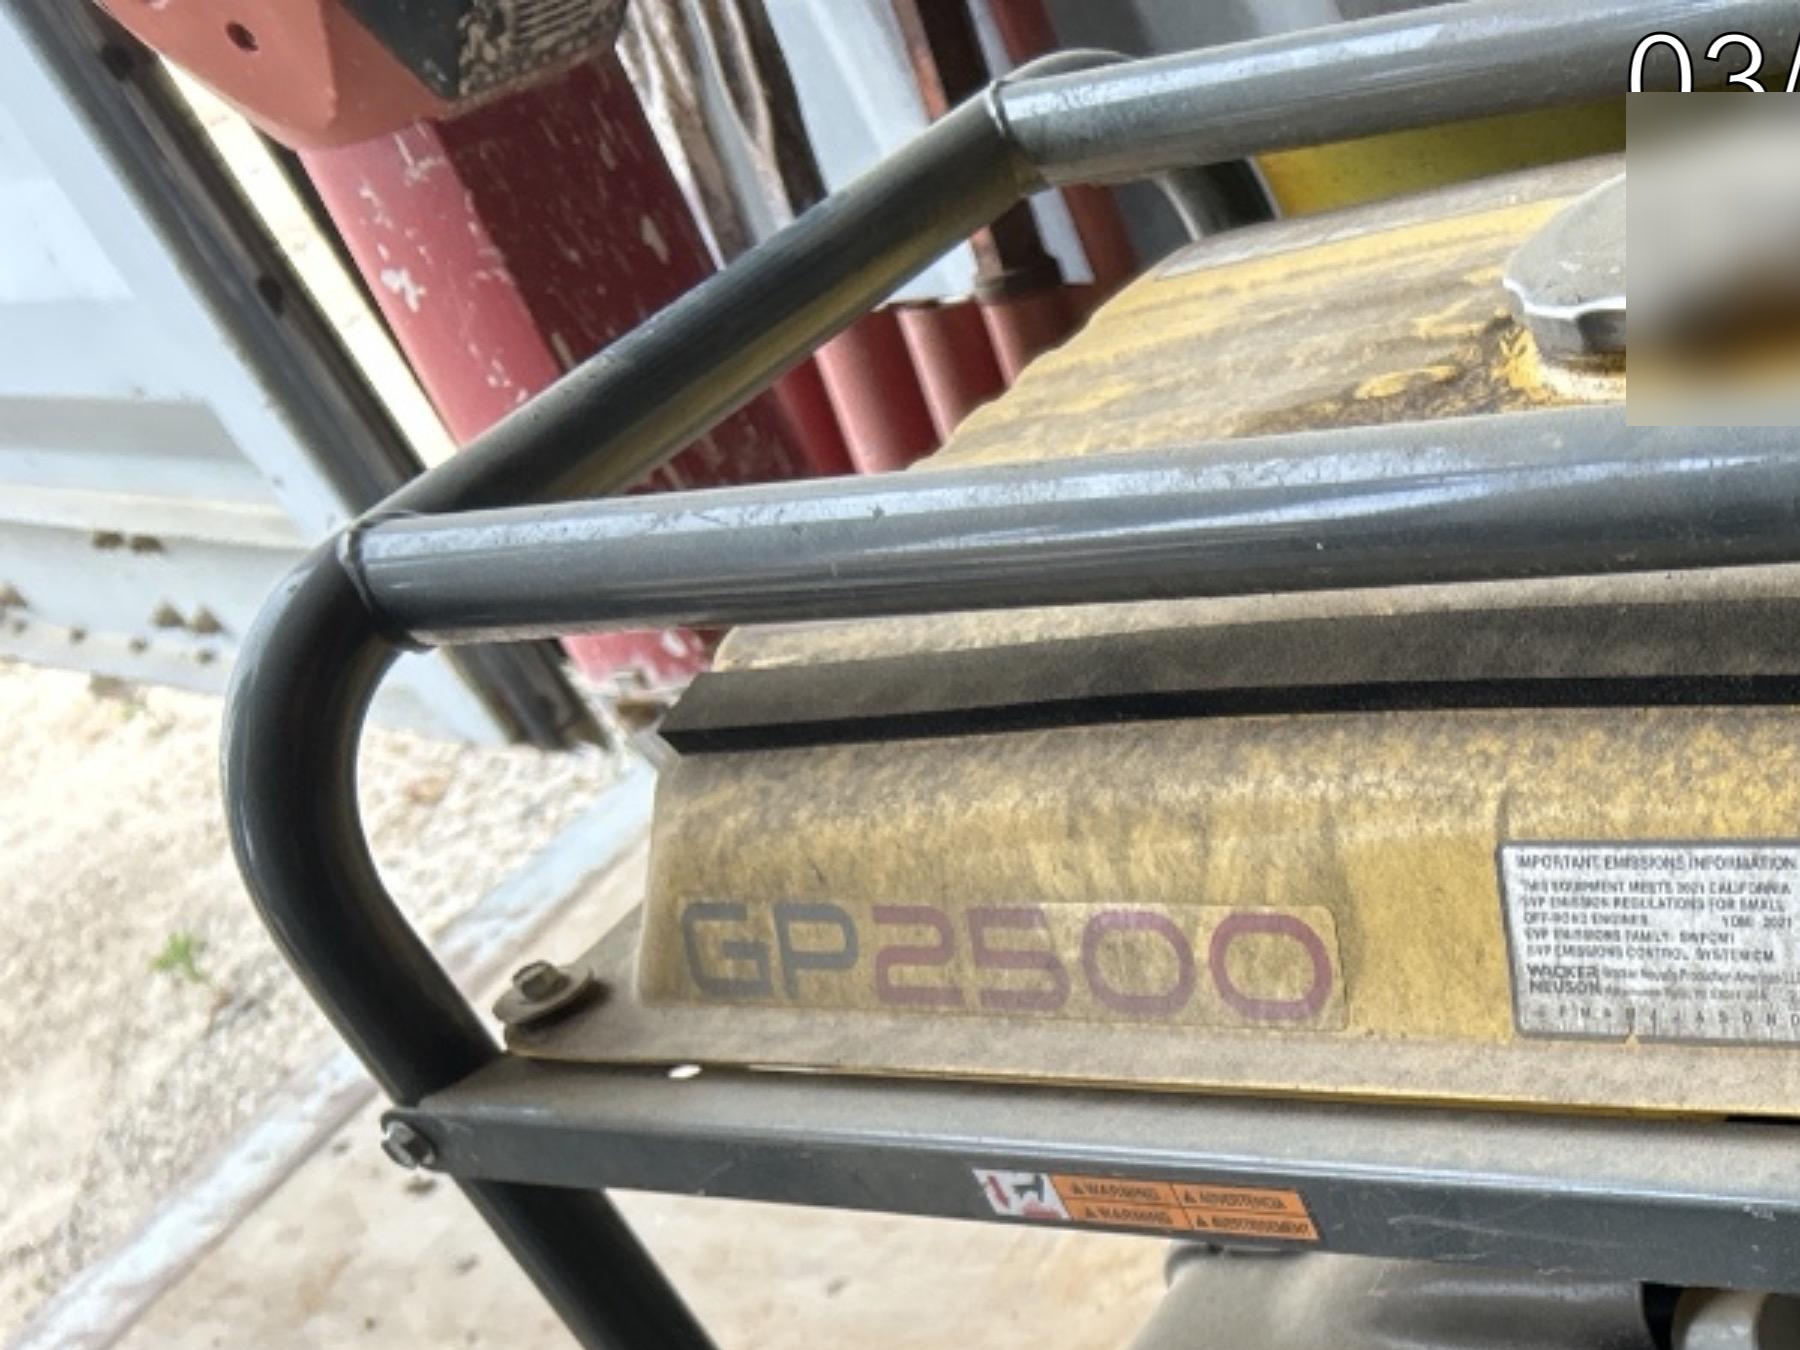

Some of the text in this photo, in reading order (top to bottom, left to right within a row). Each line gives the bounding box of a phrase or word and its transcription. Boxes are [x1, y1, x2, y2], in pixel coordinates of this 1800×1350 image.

[1516, 853, 1797, 871] IMPORTANT EMISSIONS INFORMATION
[1709, 881, 1791, 895] CALIFORNIA
[679, 900, 1333, 1021] GP2500
